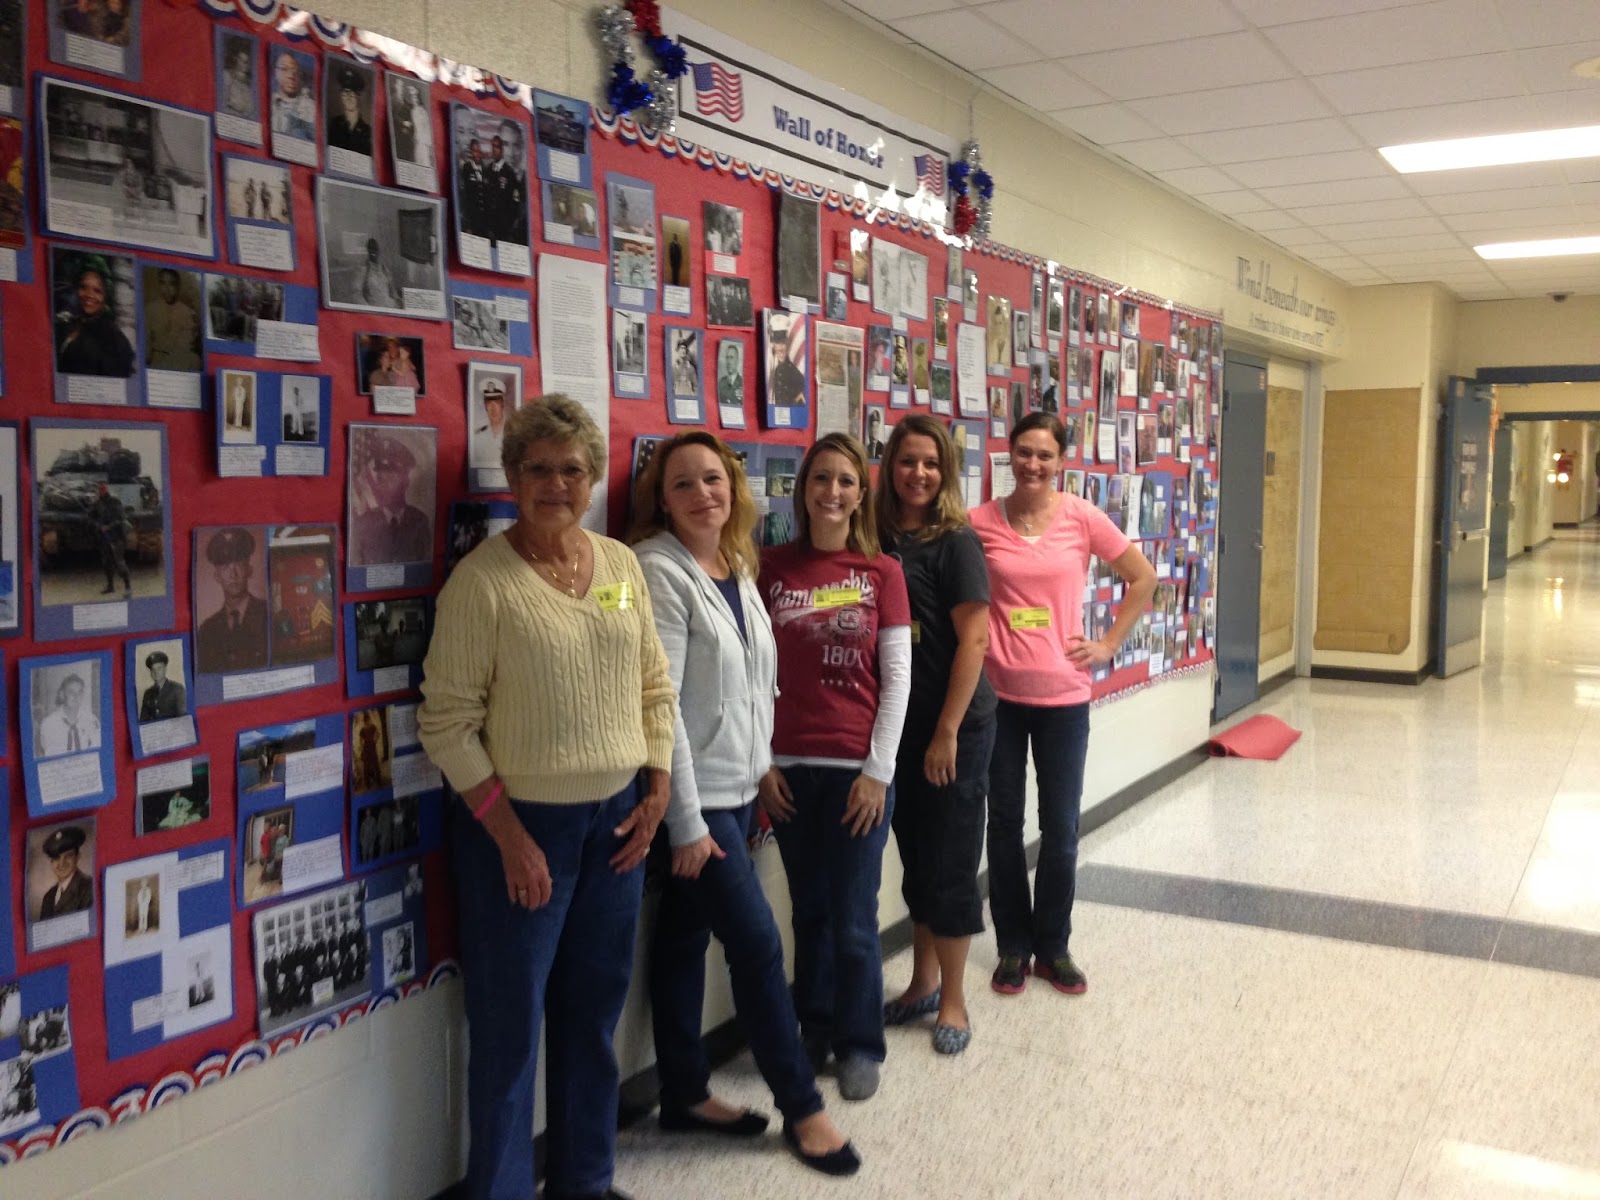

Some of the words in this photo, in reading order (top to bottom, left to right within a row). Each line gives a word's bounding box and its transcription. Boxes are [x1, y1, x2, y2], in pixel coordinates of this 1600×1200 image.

[773, 105, 811, 141] Wall
[815, 128, 834, 149] of
[836, 131, 884, 168] Honr
